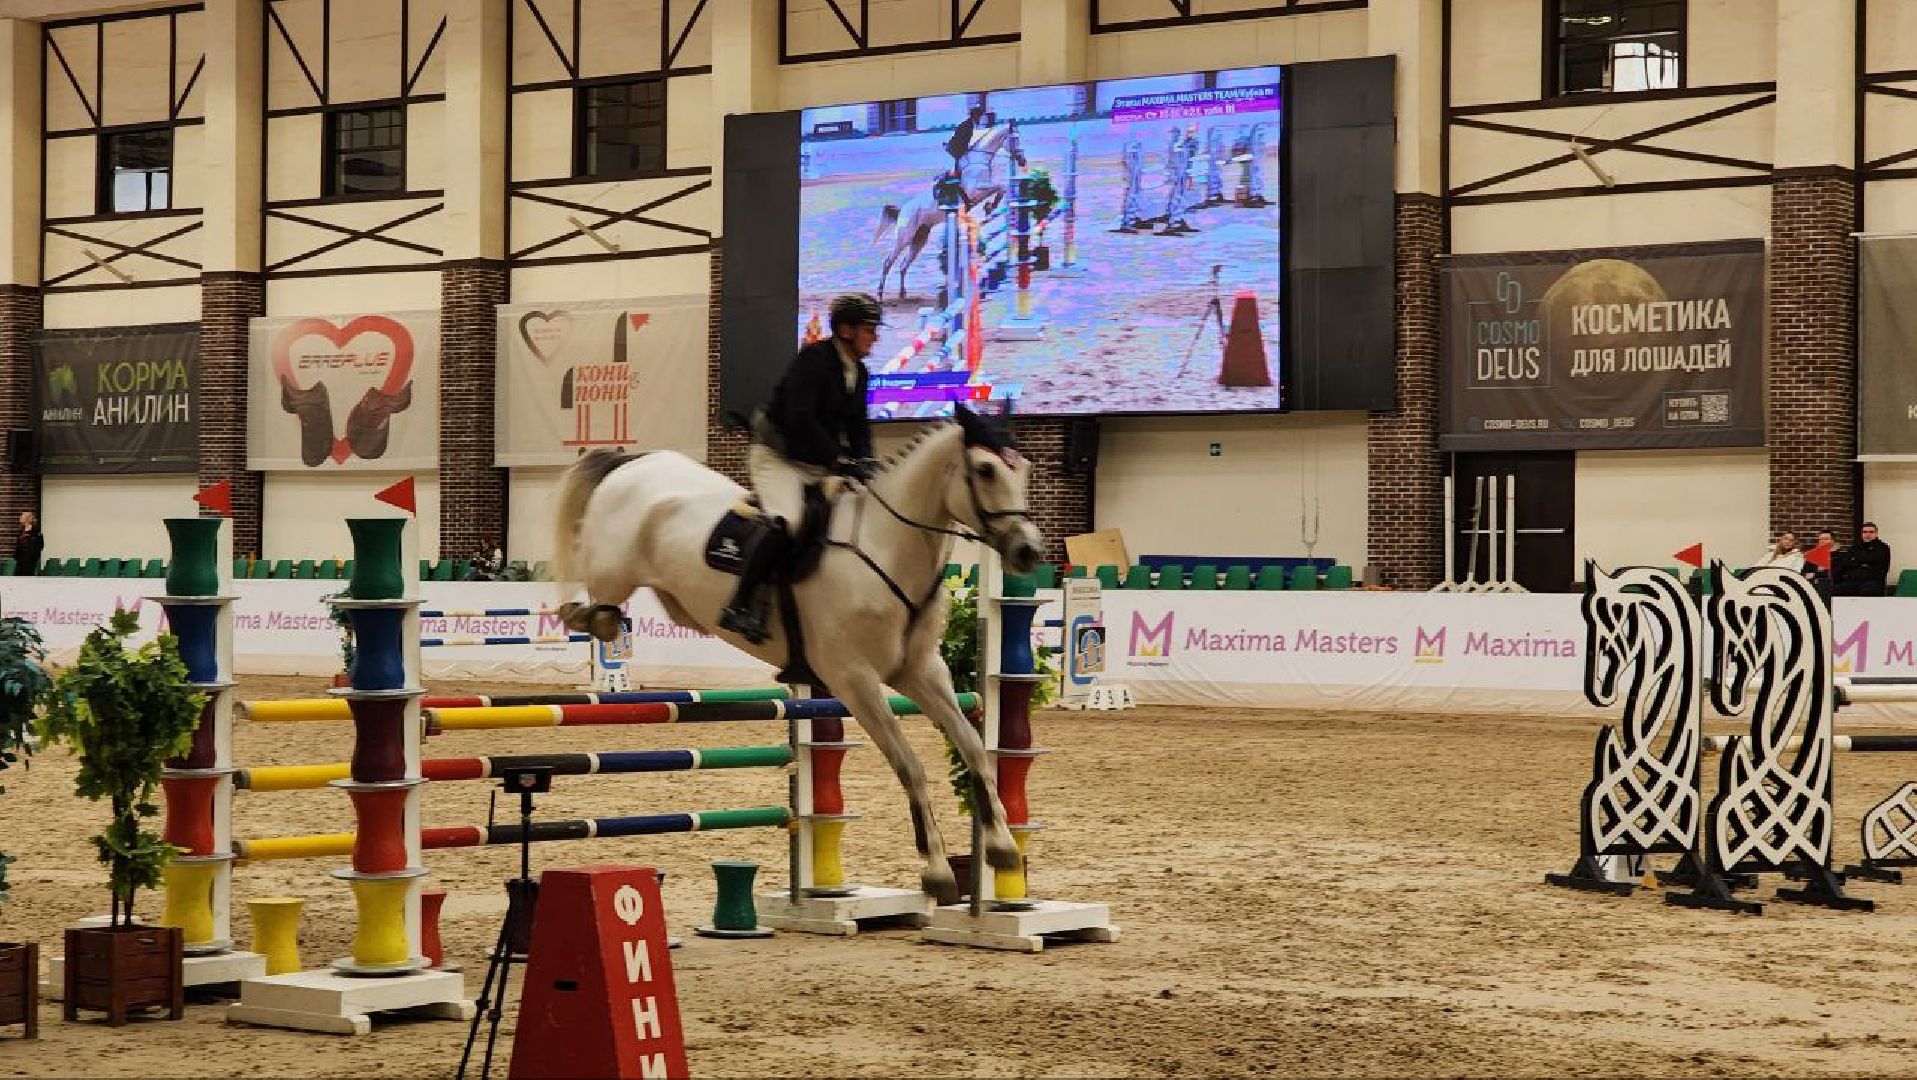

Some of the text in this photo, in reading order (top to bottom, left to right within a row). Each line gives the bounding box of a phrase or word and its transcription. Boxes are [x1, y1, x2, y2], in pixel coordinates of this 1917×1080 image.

[1571, 298, 1731, 336] КОСМЕТИКА
[1478, 320, 1540, 345] COSMO
[1477, 346, 1540, 381] DEUS
[1571, 339, 1731, 377] ДЛЯ ЛОШАДЕЙ
[99, 359, 189, 393] КОРМА
[91, 393, 189, 426] АНИЛИН
[266, 611, 332, 631] Masters
[453, 615, 527, 636] Masters
[637, 616, 715, 639] Maxim
[1184, 628, 1398, 654] Maxima Masters
[1463, 631, 1577, 658] Maxima
